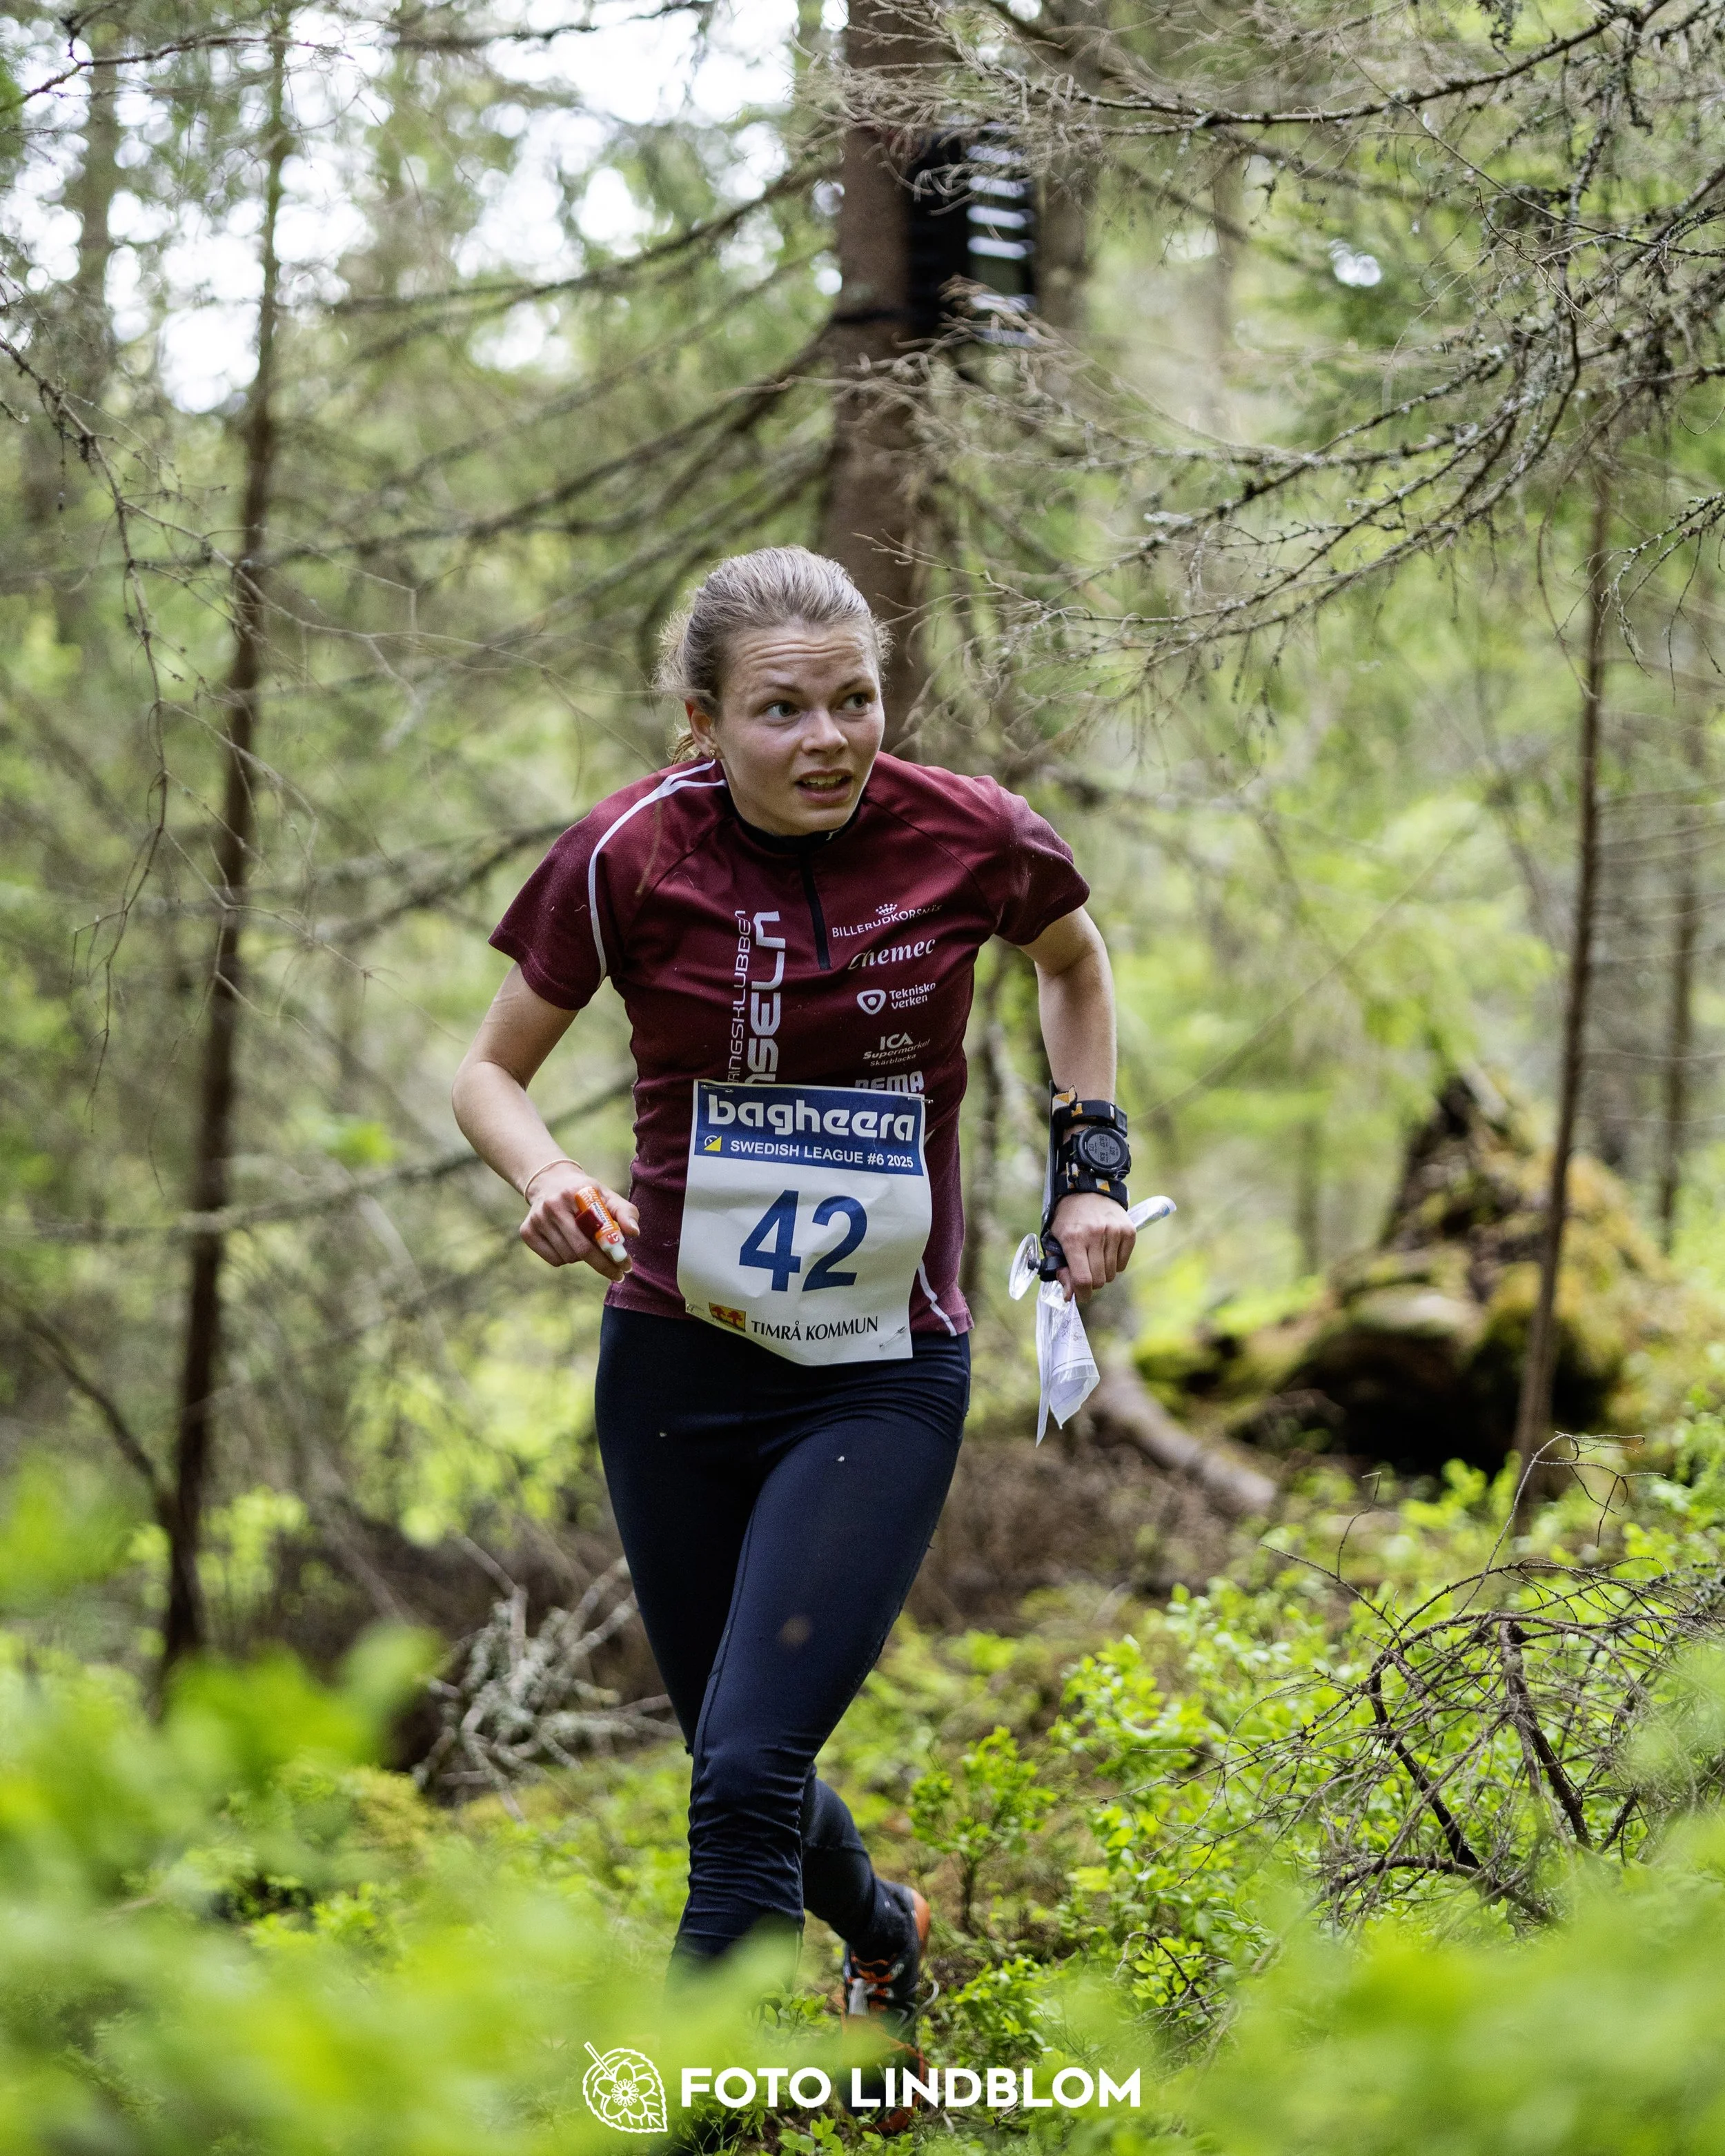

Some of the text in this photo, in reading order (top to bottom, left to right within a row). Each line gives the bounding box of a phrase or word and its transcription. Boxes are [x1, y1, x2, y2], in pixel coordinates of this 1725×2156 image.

[727, 910, 751, 1083] RINGSKLUBBEN
[891, 994, 928, 1010] verken
[862, 1038, 931, 1060] Supermarket
[880, 1032, 914, 1051] ICA
[869, 1054, 917, 1067] Skärblacka
[708, 1094, 916, 1142] bagheera
[730, 1140, 914, 1168] SWEDISH LEAGUE #6 2025
[738, 1189, 868, 1292] 42
[751, 1316, 878, 1341] TIMRÅ KOMMUN
